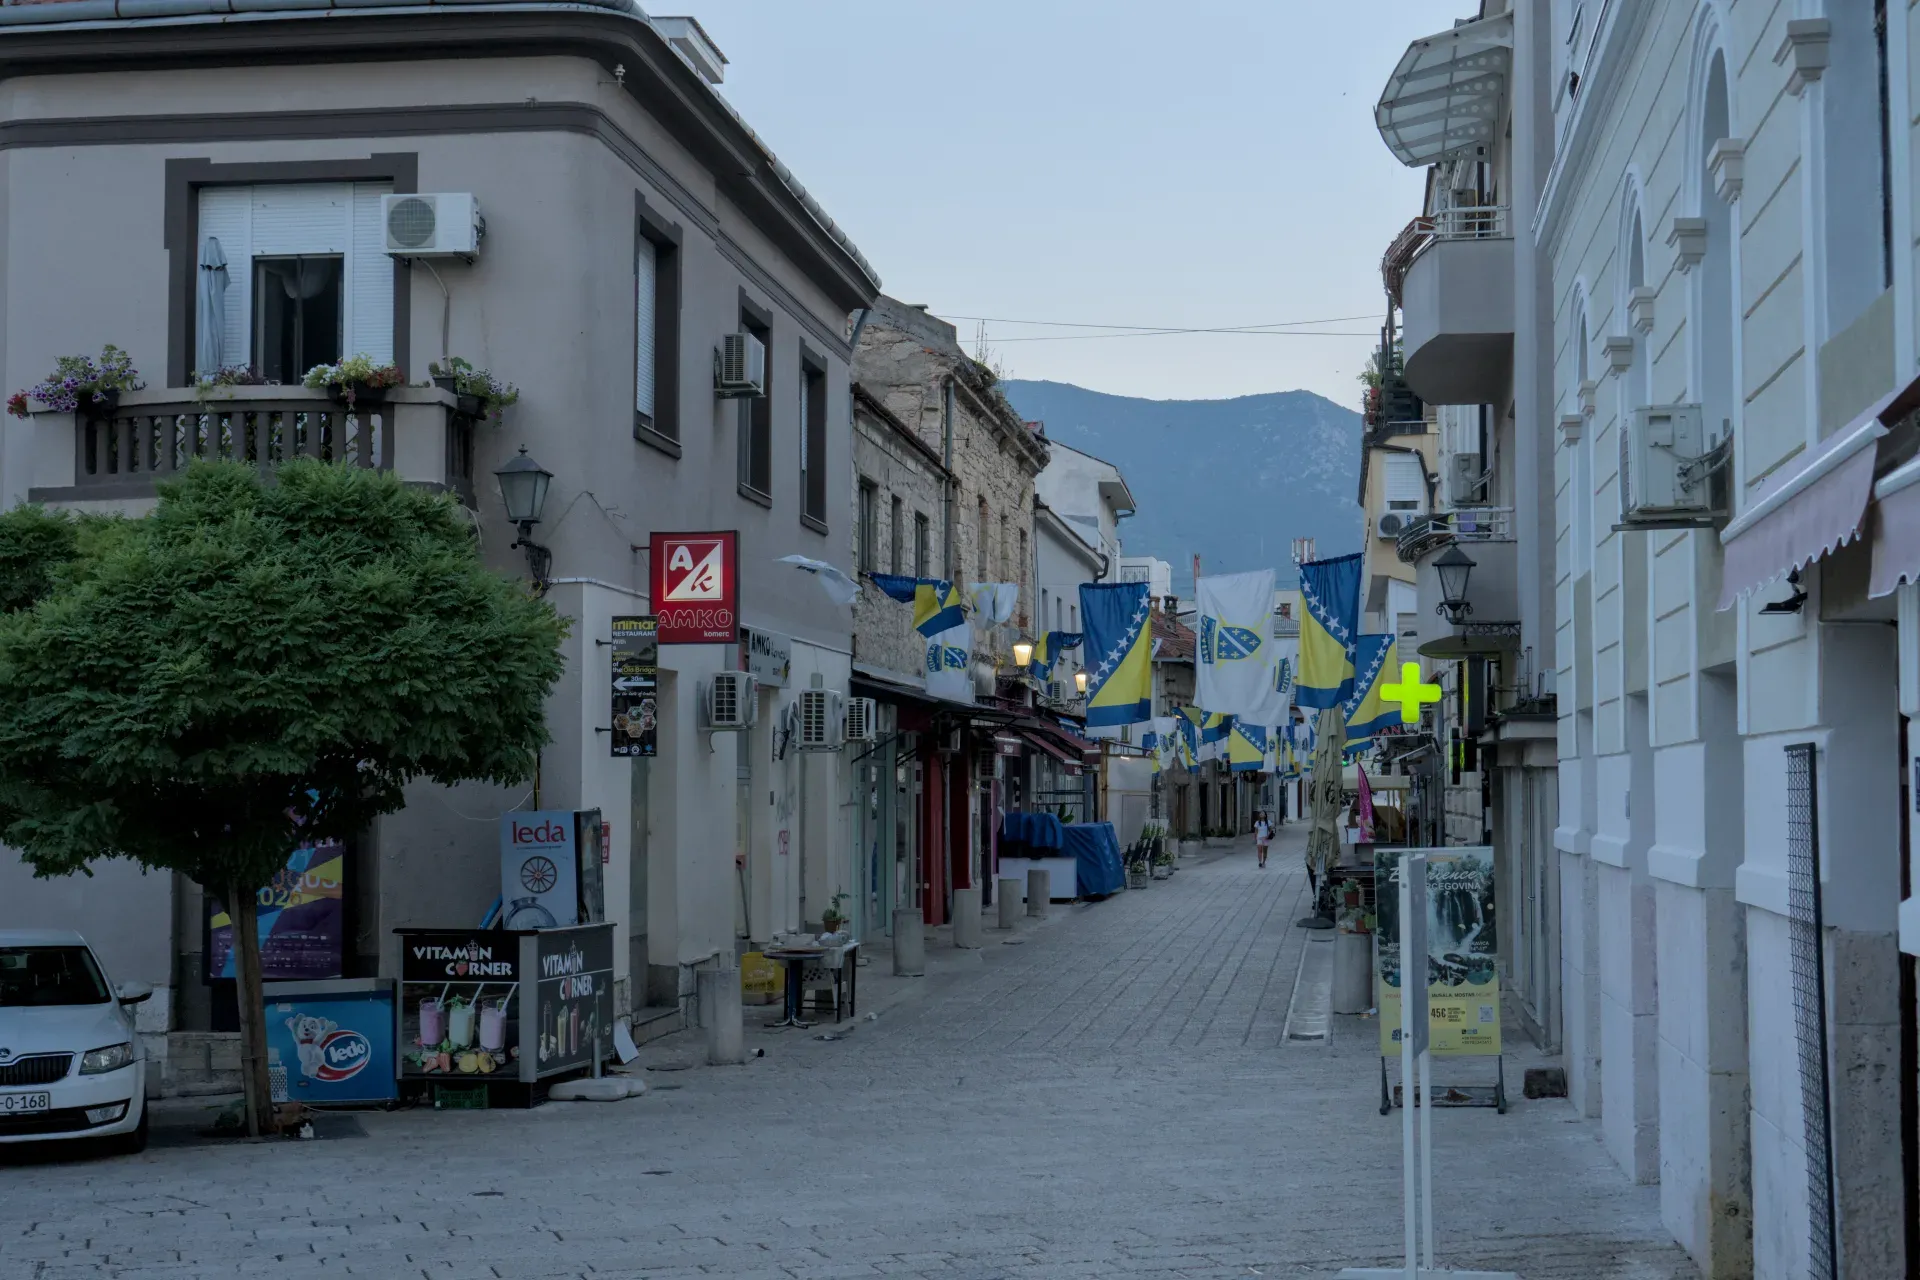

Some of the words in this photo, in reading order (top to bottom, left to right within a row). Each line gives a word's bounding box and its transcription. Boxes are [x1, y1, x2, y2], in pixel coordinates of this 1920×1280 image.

[612, 620, 657, 630] mimar
[657, 608, 733, 628] AMKO
[751, 632, 771, 657] AMKO
[635, 666, 657, 675] Bridge
[512, 820, 566, 844] leda
[412, 945, 492, 961] VITAMIN
[1430, 1007, 1447, 1018] 45€
[329, 1040, 366, 1064] ledo
